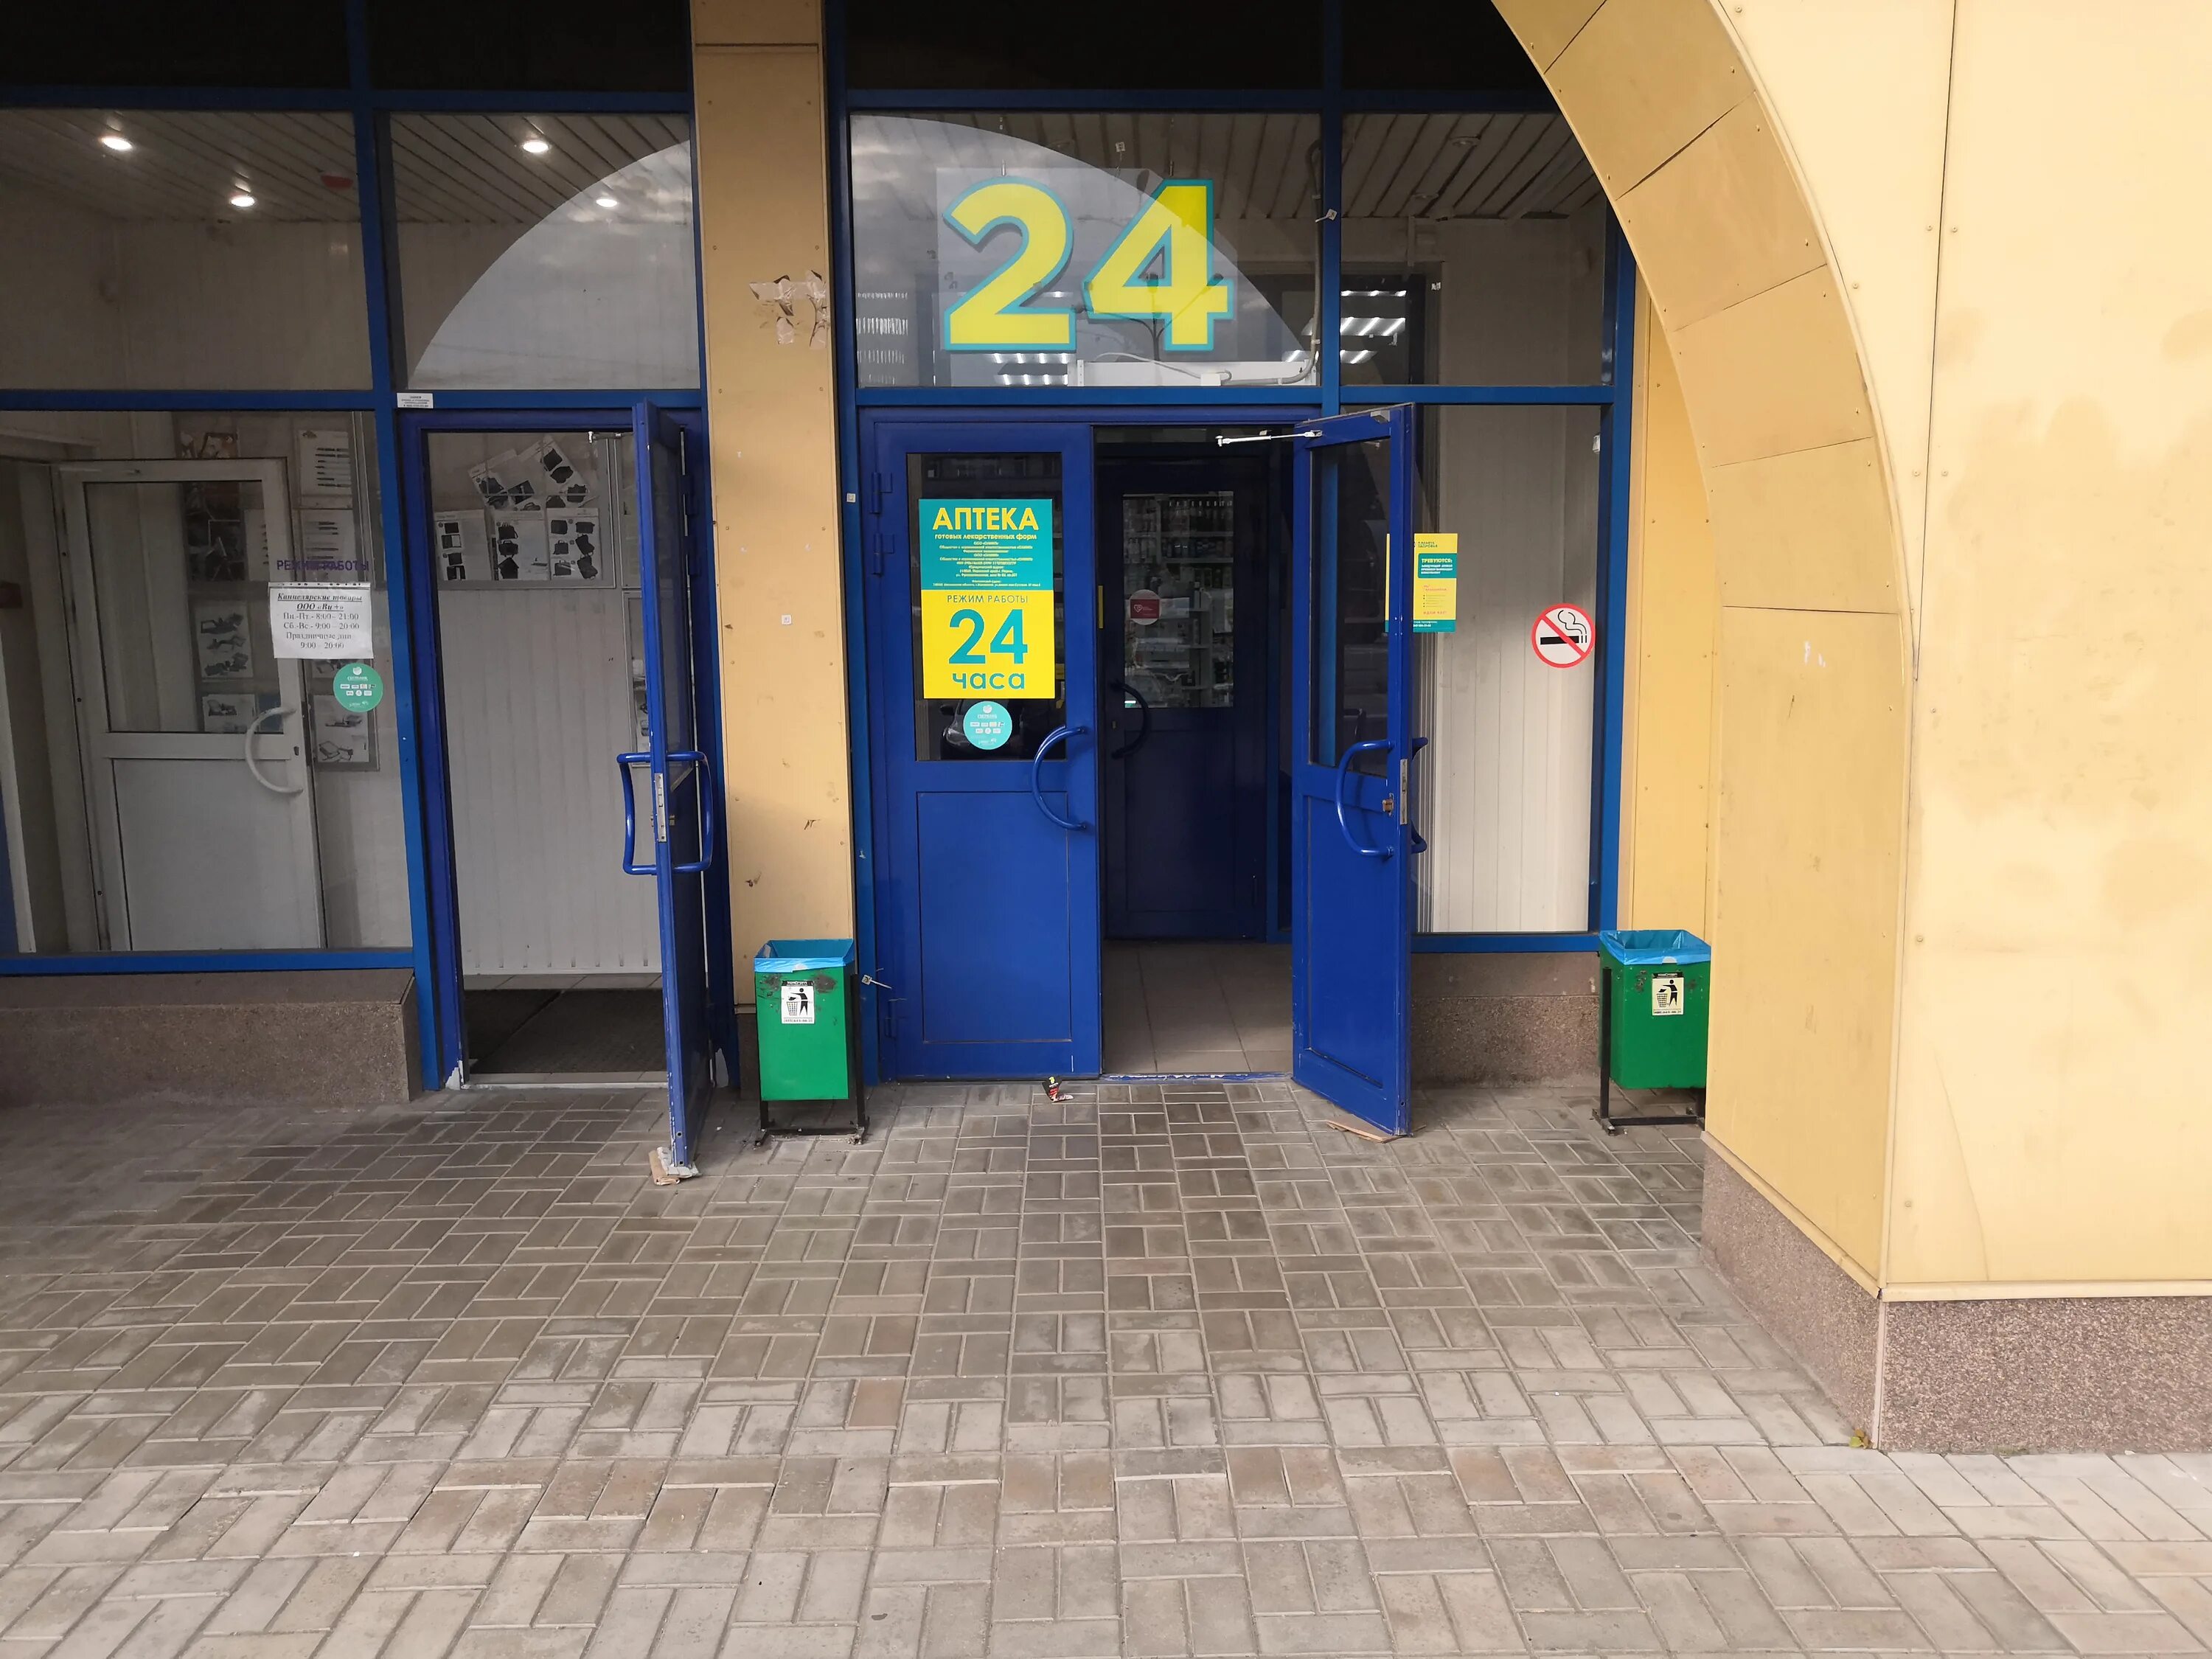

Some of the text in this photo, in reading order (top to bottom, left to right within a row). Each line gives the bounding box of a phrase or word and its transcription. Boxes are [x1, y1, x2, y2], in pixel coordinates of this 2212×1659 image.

[942, 175, 1234, 350] 24
[932, 507, 1039, 530] АПТЕКА
[987, 595, 1028, 603] РАБОТЫ
[948, 608, 1028, 664] 24
[952, 672, 1025, 689] часа
